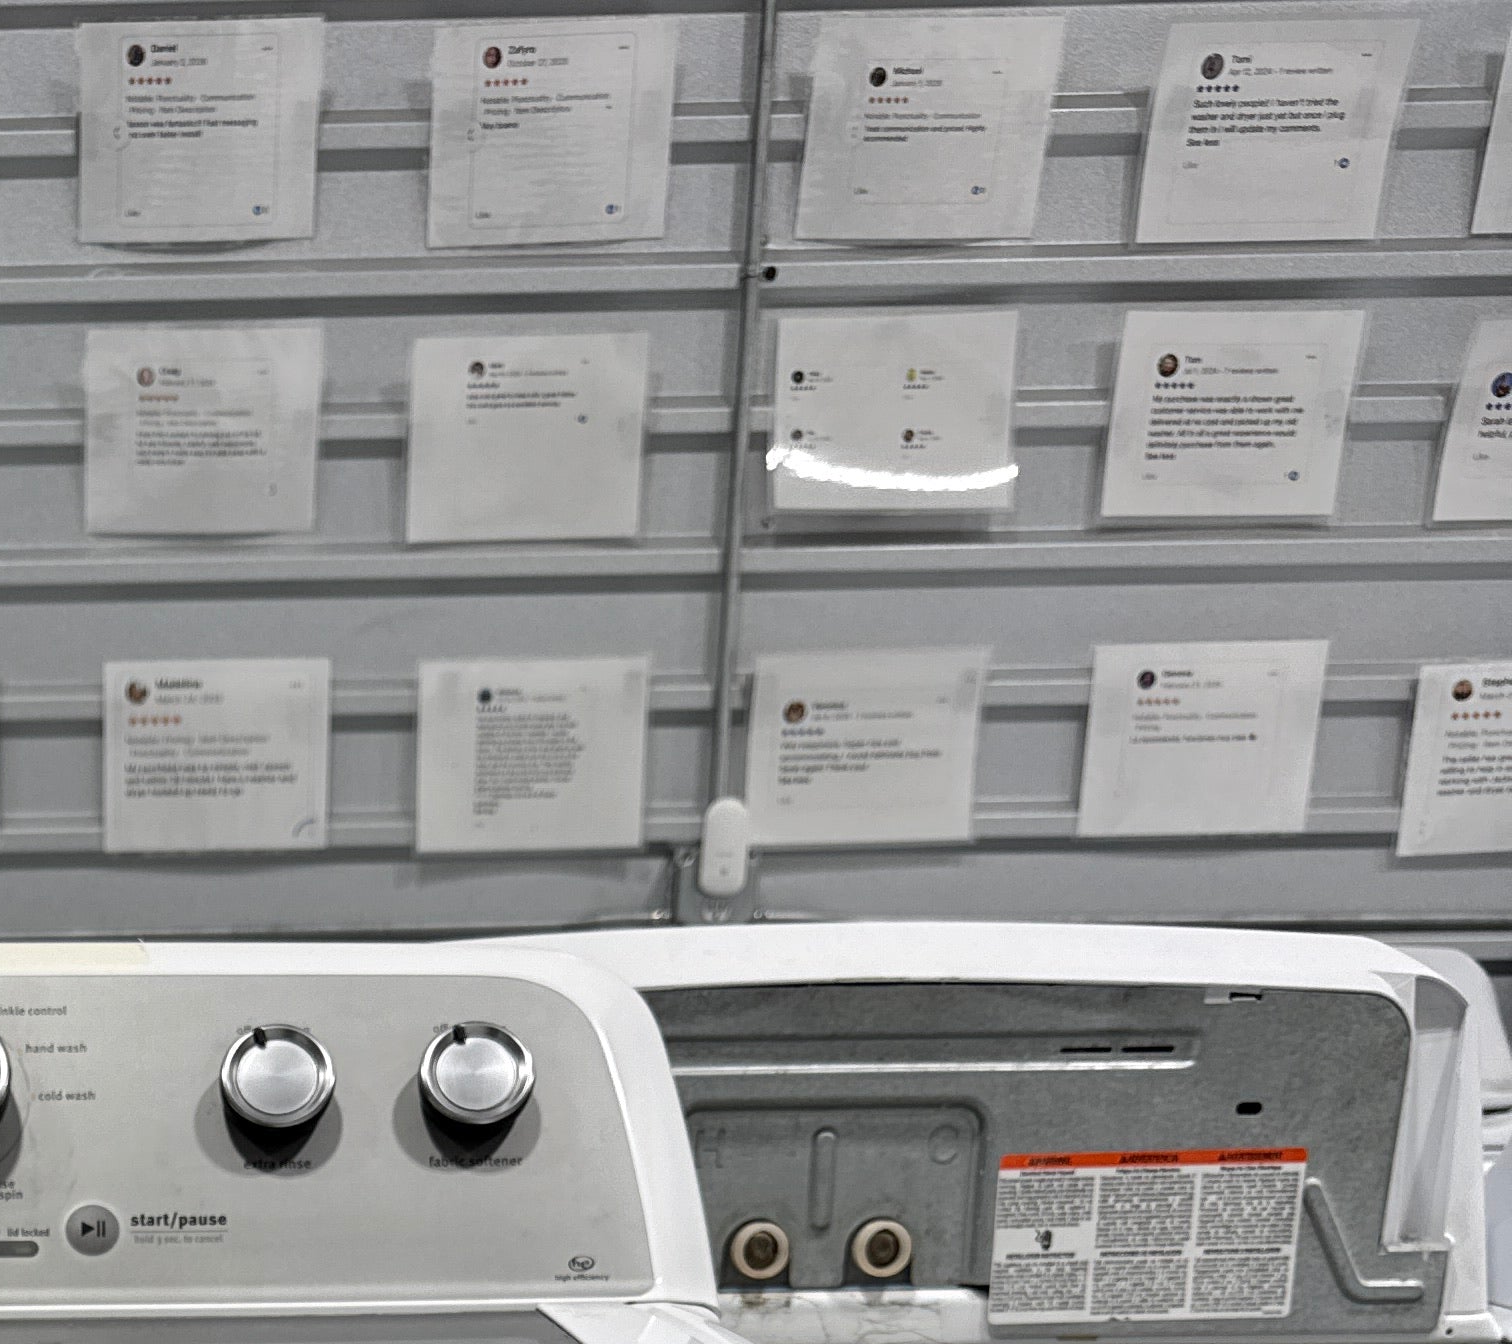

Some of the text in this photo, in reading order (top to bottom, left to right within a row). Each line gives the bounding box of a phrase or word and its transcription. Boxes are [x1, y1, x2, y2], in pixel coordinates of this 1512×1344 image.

[28, 1006, 67, 1016] control
[25, 1043, 87, 1054] hand wash
[38, 1091, 96, 1101] cold wash
[244, 1160, 276, 1170] extra
[429, 1156, 523, 1168] fabric softener
[0, 1190, 23, 1202] spin
[130, 1212, 227, 1230] start/pause
